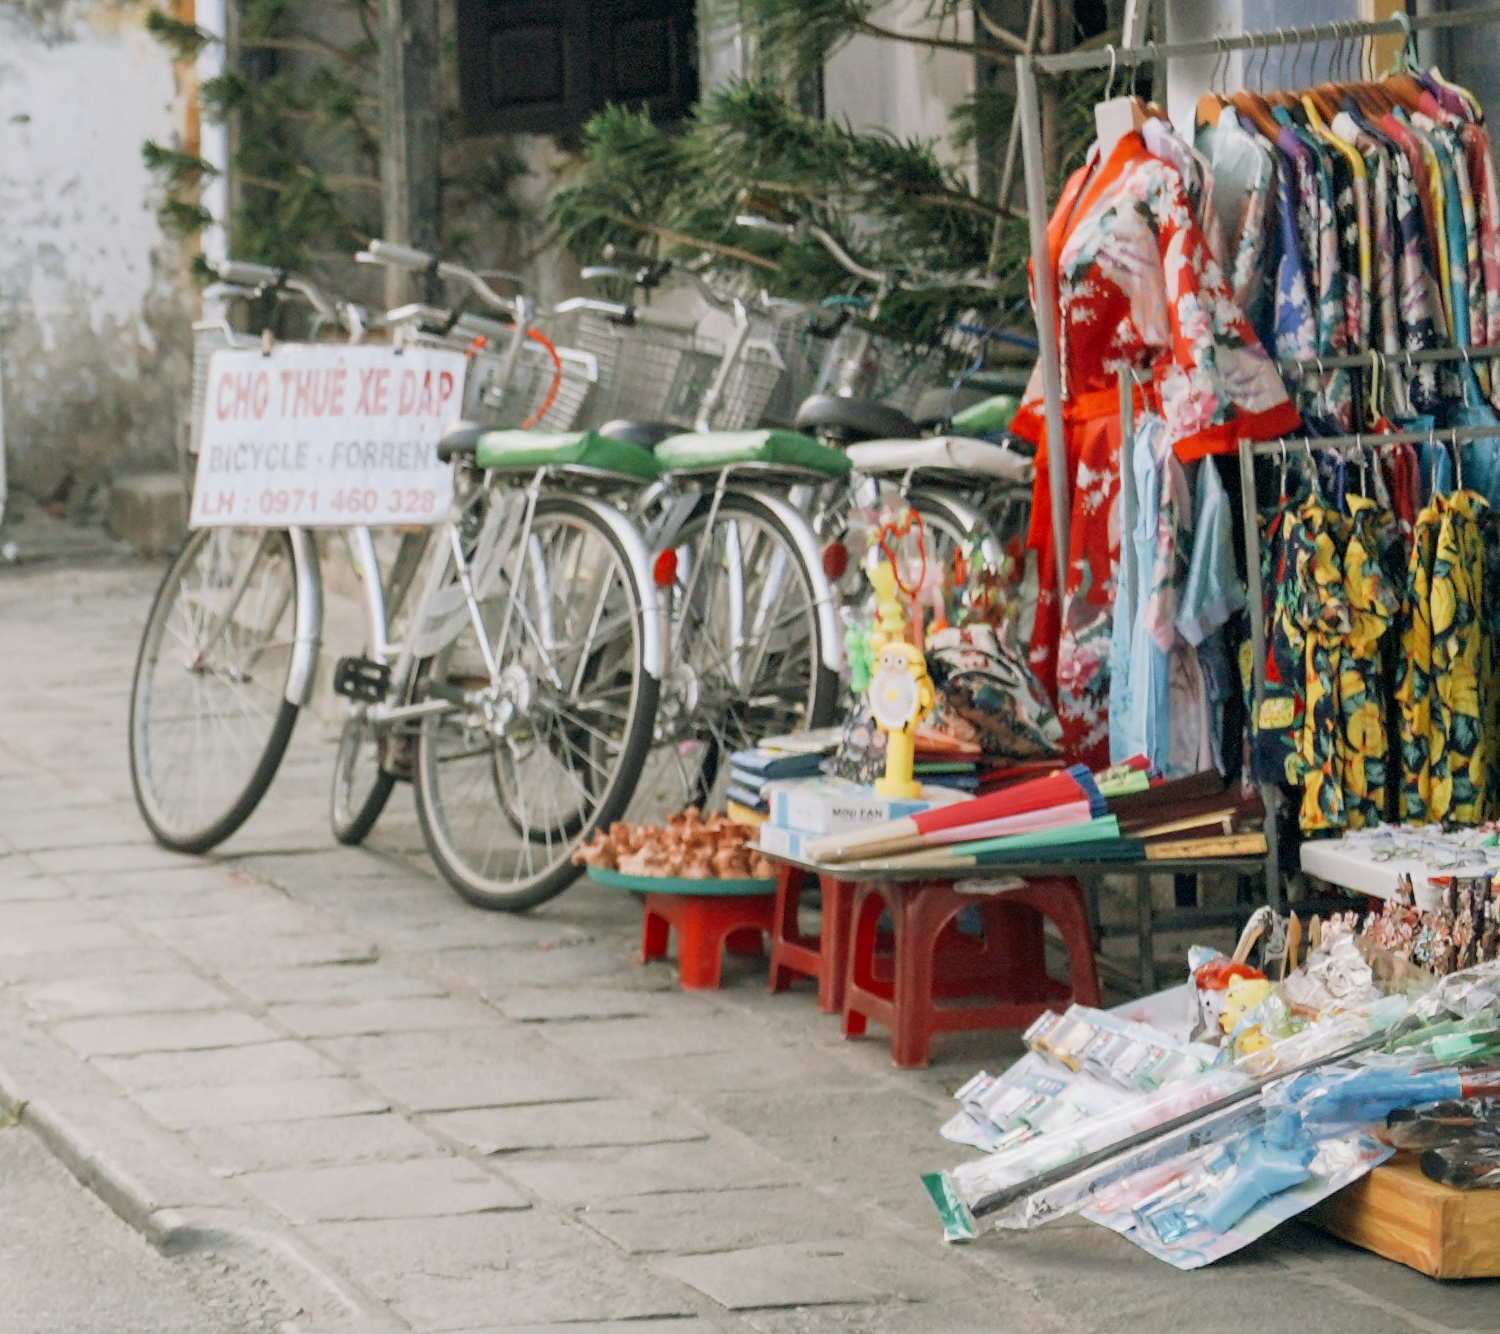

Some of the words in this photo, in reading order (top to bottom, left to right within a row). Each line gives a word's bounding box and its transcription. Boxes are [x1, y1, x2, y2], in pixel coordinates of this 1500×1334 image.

[217, 371, 269, 421] CHO
[355, 367, 390, 417] XE
[209, 441, 309, 473] BICYCLE
[201, 490, 235, 516] LH
[258, 488, 319, 515] 0971
[330, 488, 378, 515] 460
[388, 488, 436, 514] 328
